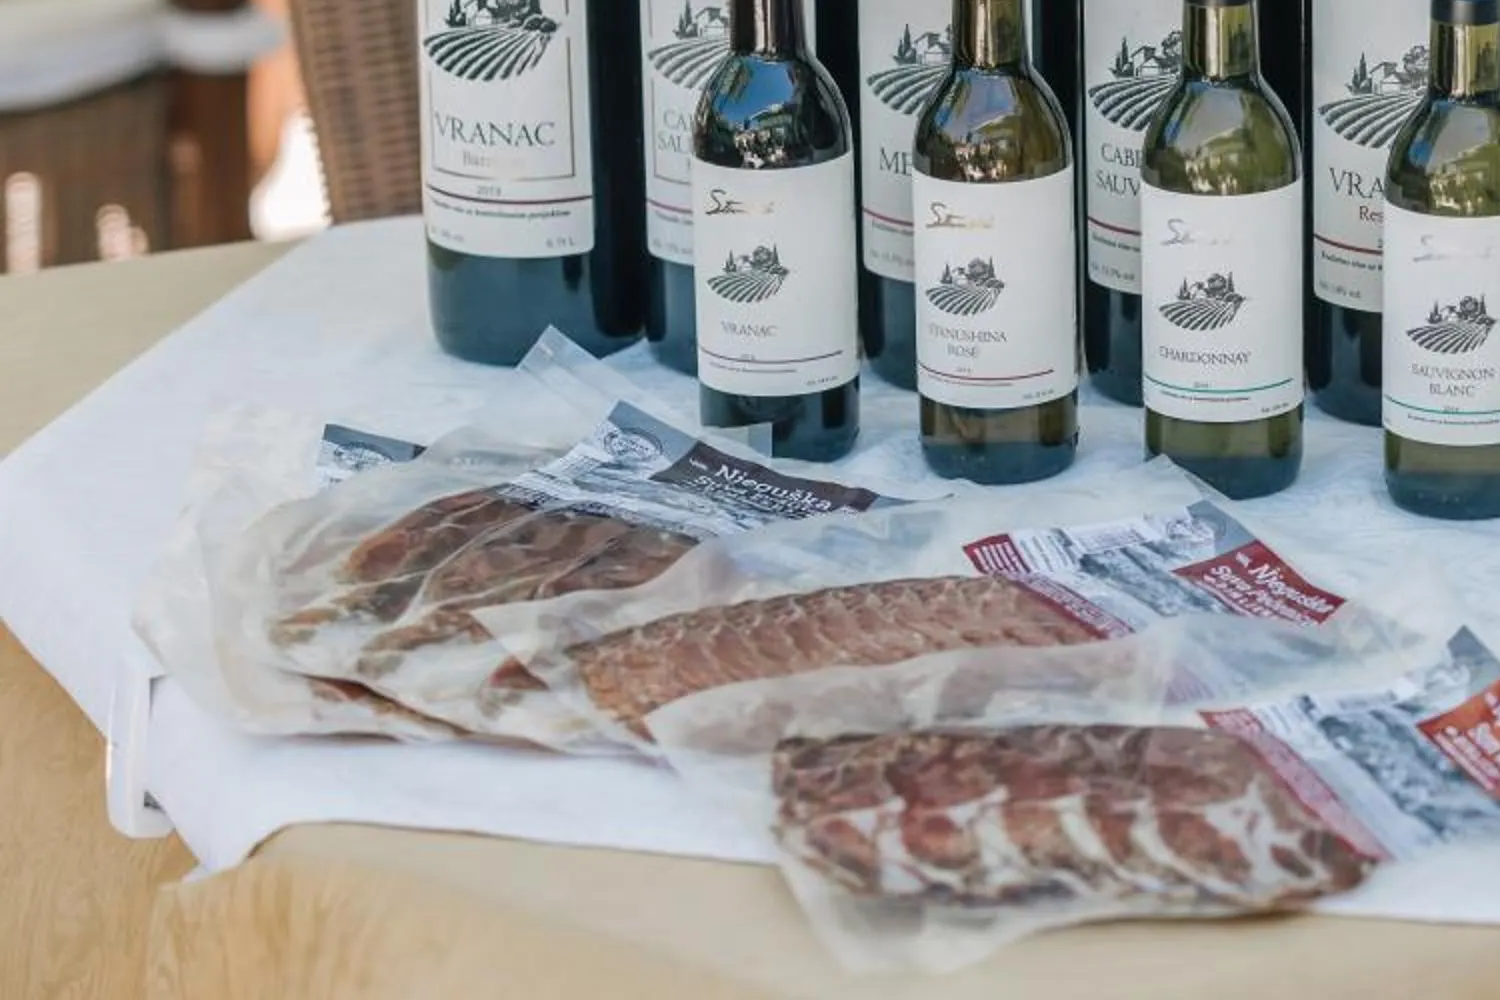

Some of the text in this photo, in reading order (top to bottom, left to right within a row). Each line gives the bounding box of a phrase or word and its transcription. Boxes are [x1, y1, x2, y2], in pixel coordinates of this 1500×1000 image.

[434, 110, 556, 147] VRANAC
[879, 146, 913, 177] ME
[1095, 169, 1141, 197] SAUV
[1328, 166, 1384, 200] VRA
[1359, 205, 1384, 222] Res
[1158, 345, 1252, 366] CHARDONNAY
[1411, 362, 1497, 381] SAUVIGNON
[1429, 383, 1475, 398] BLANC
